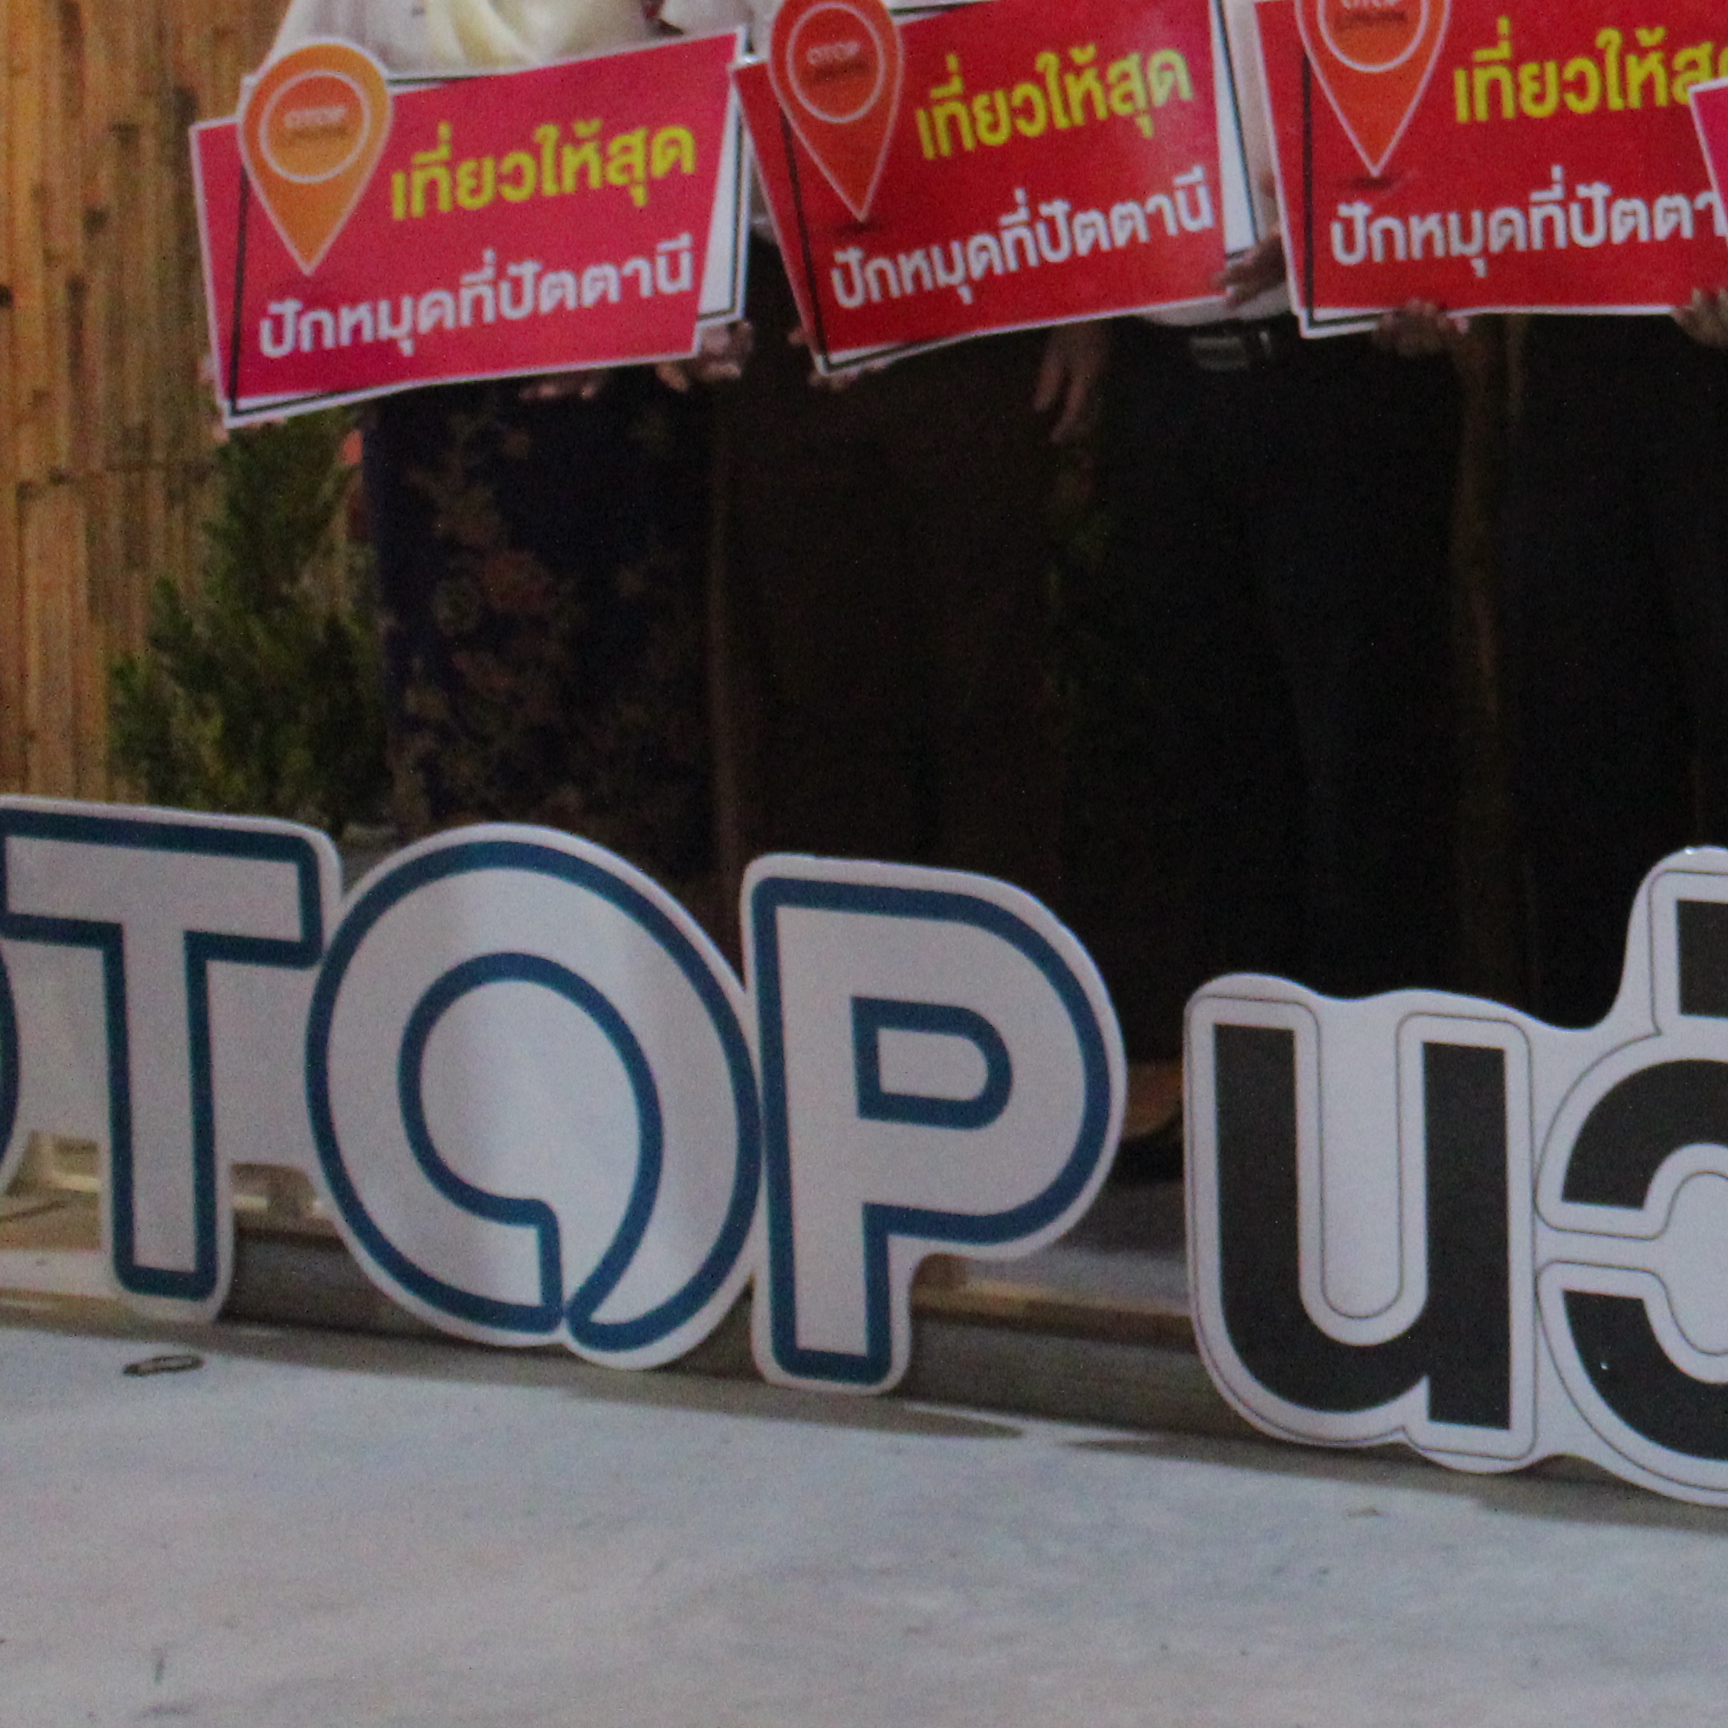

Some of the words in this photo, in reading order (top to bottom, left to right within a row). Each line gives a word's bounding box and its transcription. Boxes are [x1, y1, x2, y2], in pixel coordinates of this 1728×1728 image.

[914, 44, 1193, 160] เที่ยวให้สุด
[392, 118, 695, 220] เที่ยวให้สุด
[260, 232, 693, 357] ปักหมุดที่ปัตตานี
[831, 165, 1215, 310] ปักหมุดที่ปัตตานี
[0, 807, 1113, 1385] TOP
